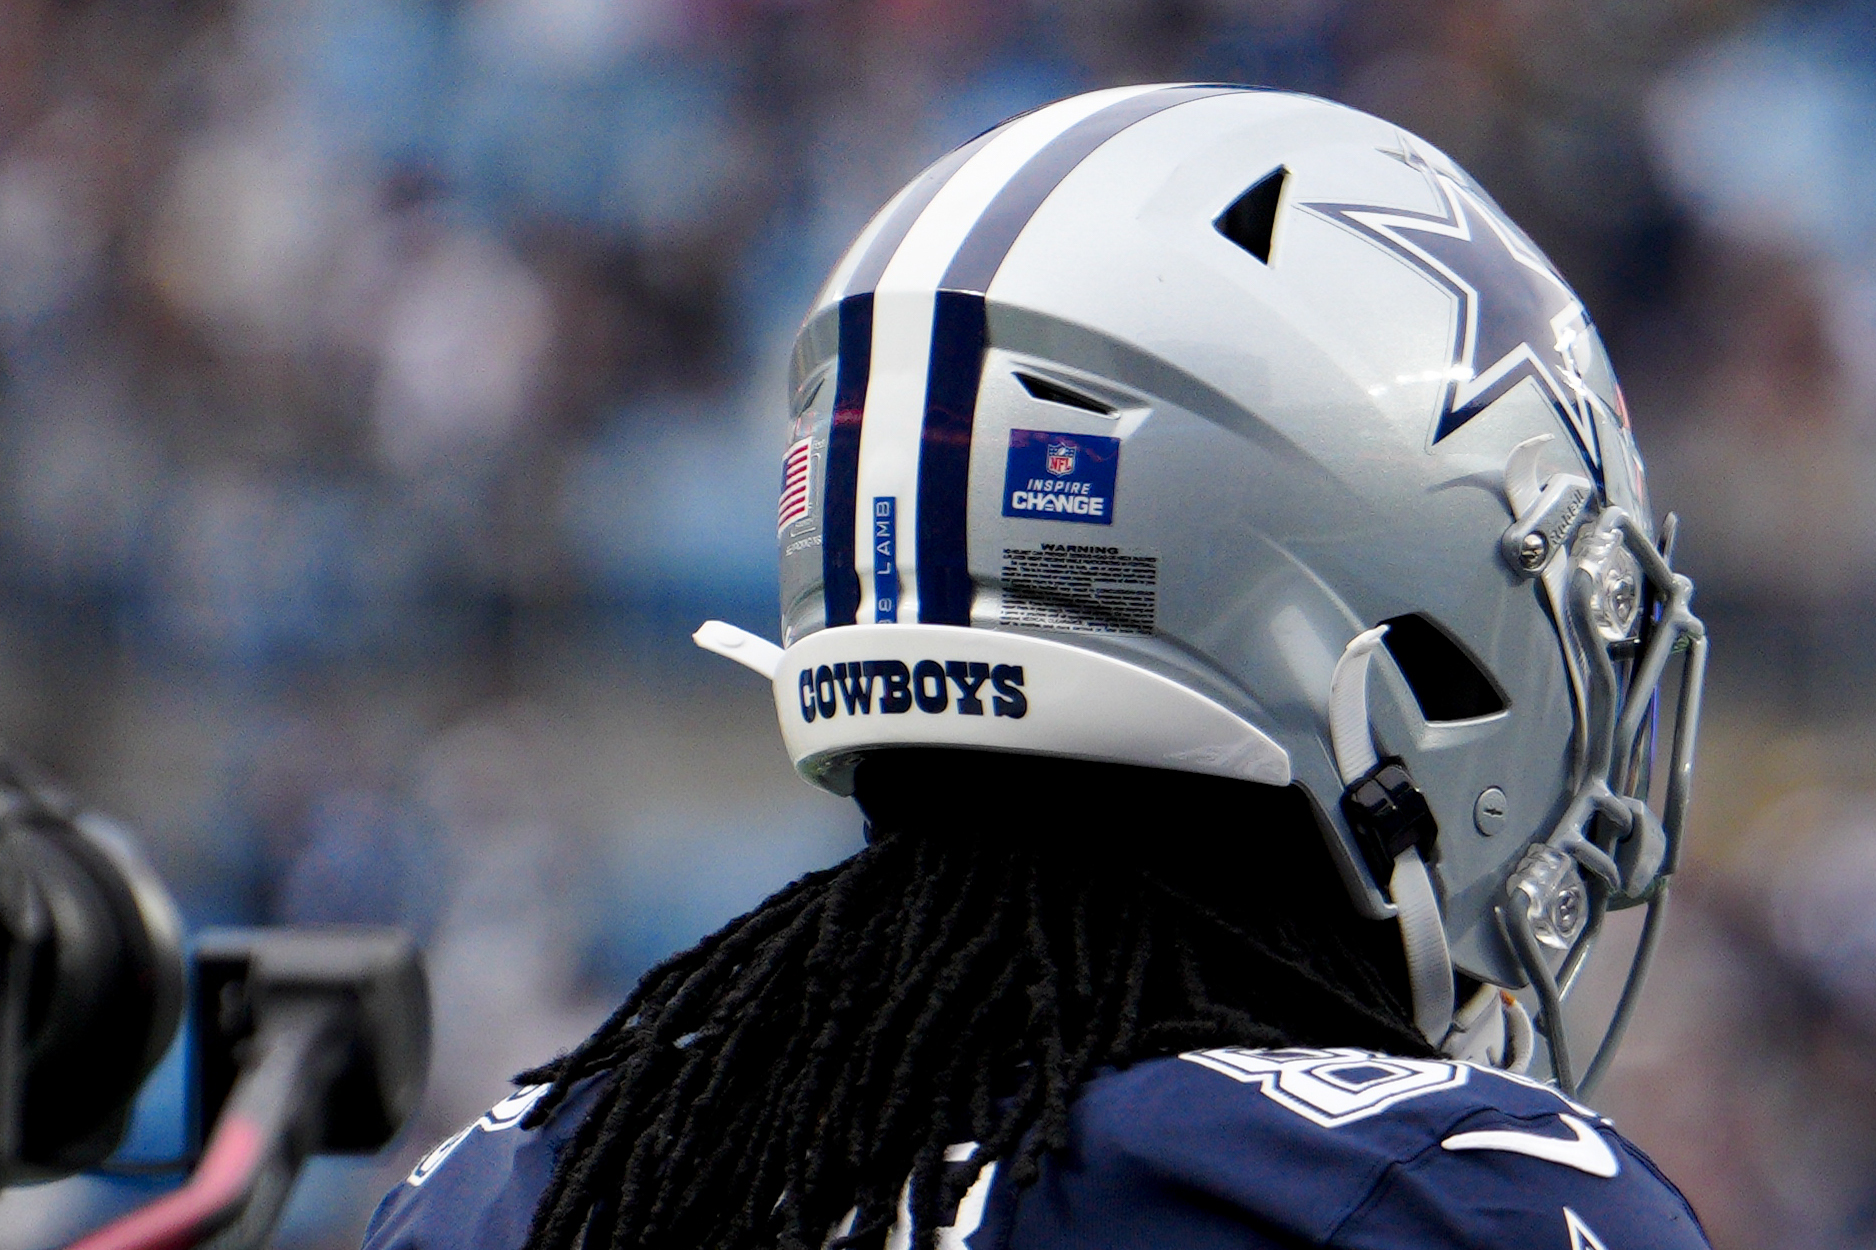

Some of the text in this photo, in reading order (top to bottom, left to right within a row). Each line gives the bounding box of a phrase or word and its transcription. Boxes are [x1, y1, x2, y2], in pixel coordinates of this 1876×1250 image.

[1027, 478, 1091, 495] INSPIRE
[1012, 491, 1104, 516] CHANGE
[1040, 543, 1120, 555] WARNING
[876, 501, 892, 624] 8 LAMB
[798, 660, 1028, 723] COWBOYS
